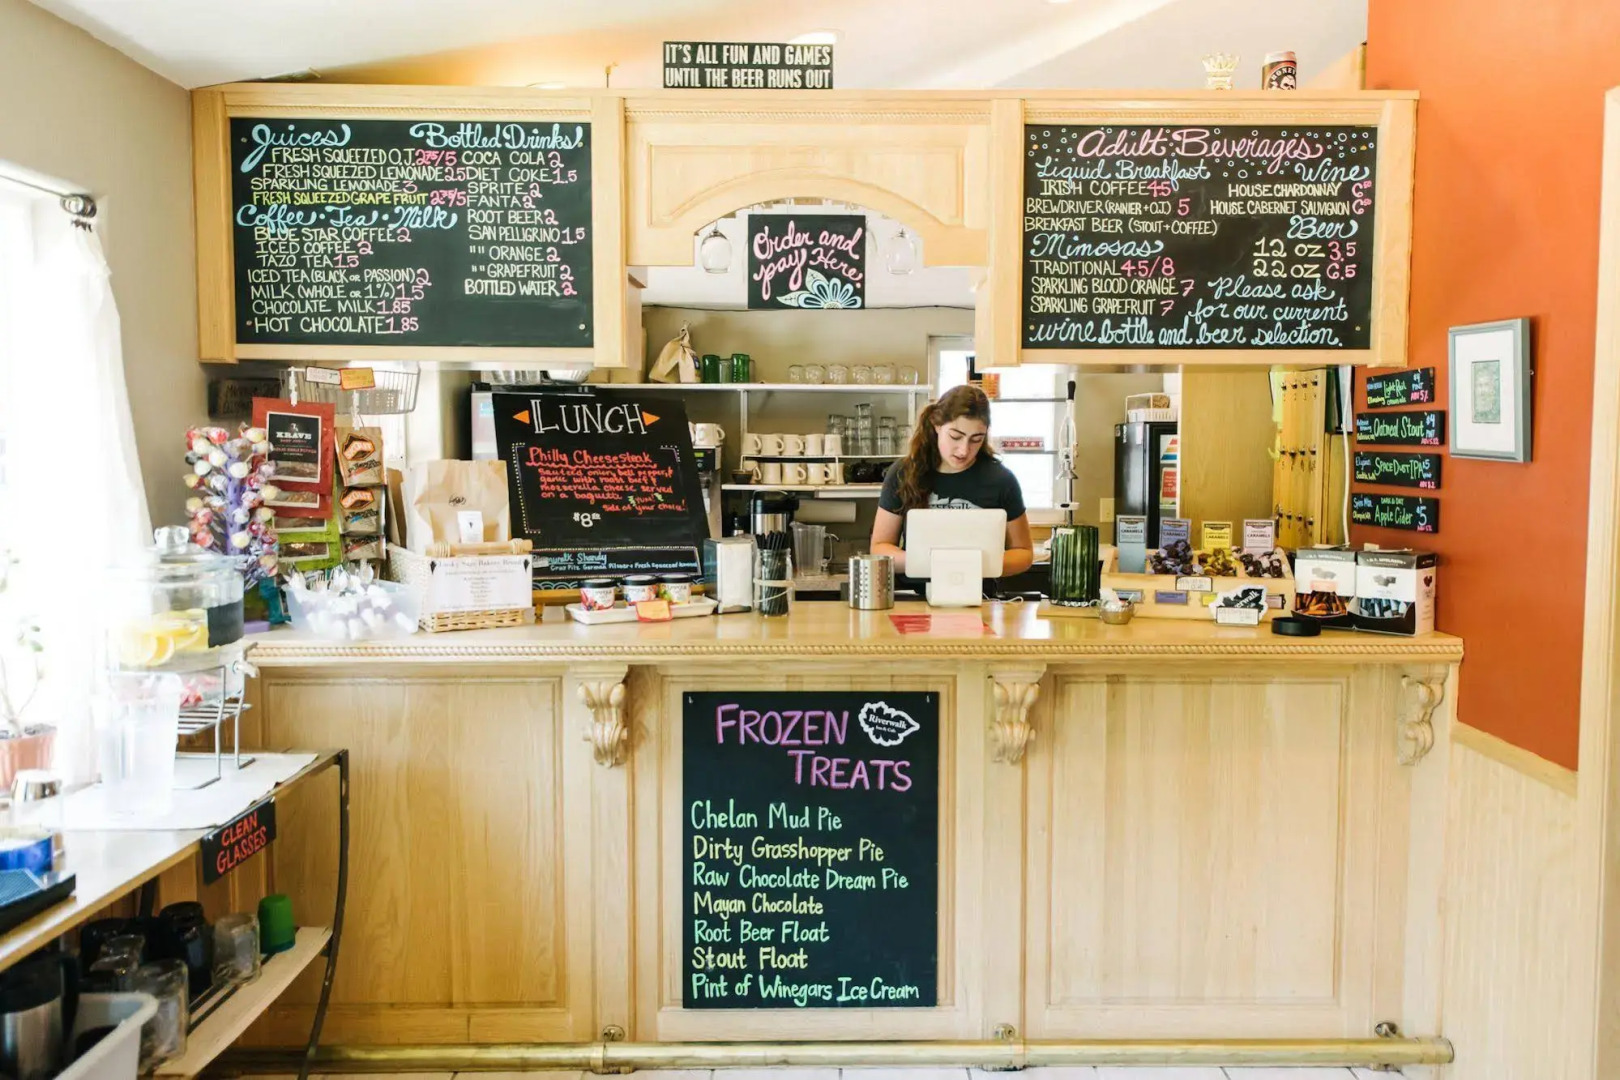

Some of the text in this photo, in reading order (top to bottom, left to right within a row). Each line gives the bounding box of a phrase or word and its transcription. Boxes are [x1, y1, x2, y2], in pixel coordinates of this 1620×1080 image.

[665, 44, 831, 65] IT'S ALL FUN AND GAMES
[665, 68, 831, 88] UNTIL THE BEER RUNS OUT
[409, 122, 502, 148] Bottled
[240, 124, 351, 173] Juices
[272, 147, 387, 165] FRESH SQUEEZED
[461, 150, 564, 168] COCA COLA 2
[1077, 128, 1323, 175] Adult Beverages
[263, 164, 444, 181] FRESH SQUEEZED LEMONADE
[466, 167, 553, 182] DIET COKE
[1035, 156, 1211, 192] Liquid Breakfast
[1294, 158, 1370, 182] Wine
[251, 177, 418, 193] SPARKLING LEMONADE 3
[467, 181, 543, 198] SPRITE 2
[1040, 179, 1149, 196] IRISH COFFEE
[1228, 182, 1342, 197] HOUSE CHARDONNAY
[253, 192, 428, 205] FRESH SQUEEZED GRAPE FRUIT
[466, 195, 536, 209] FANTA 2
[1026, 198, 1190, 216] BREWDRIVER 5
[1210, 200, 1350, 215] HOUSE CABERNET SAUVIGNON
[236, 204, 458, 234] Coffee Milk
[467, 208, 559, 225] ROOT BEER 2
[1024, 216, 1123, 233] BREAKFAST BEER
[1287, 215, 1359, 239] Beer
[254, 227, 412, 242] BLUE STAR COFFEE 2
[468, 225, 560, 242] SAN PELLIGRINO
[753, 220, 863, 260] Order and
[255, 241, 374, 255] ICED COFFEE 2
[489, 245, 561, 262] ORANGE 2
[1030, 233, 1164, 259] Mimosas
[1253, 236, 1357, 261] 12 3.5
[257, 255, 333, 267] TAZO TEA
[487, 263, 574, 280] GRAPEFRUIT 2
[1030, 260, 1121, 276] TRADITIONAL
[1253, 259, 1357, 280] 22 6.5
[248, 268, 432, 286] ICED PASSION) 2
[753, 248, 807, 301] pay
[250, 284, 346, 299] MILK (WHOLE
[464, 279, 577, 296] BOTTLED WATER 2
[1031, 276, 1195, 297] SPARKLING BLOOD ORANGE 7
[1208, 275, 1335, 301] Please ask
[252, 300, 411, 314] CHOCOLATE MILK 1.85
[1030, 295, 1175, 316] SPARKLING GRAPEFRUIT 7
[1188, 297, 1348, 324] for our current
[255, 316, 385, 334] HOT CHOCOLATE
[1029, 315, 1247, 345] wine bottle and beer
[530, 399, 647, 434] LUNCH
[1400, 415, 1425, 438] Stout
[276, 431, 312, 439] KRAVE
[529, 446, 568, 467] Philly
[1374, 504, 1393, 526] Apple
[1395, 506, 1413, 525] Cider
[577, 552, 607, 566] Shandy
[716, 703, 849, 745] FROZEN
[869, 714, 907, 730] Riverwalk
[787, 750, 912, 791] TREATS
[691, 798, 842, 830] Chelan Mud Pie
[221, 811, 257, 845] CLEAN
[216, 826, 266, 873] GLASSES
[693, 835, 884, 866] Dirty Grasshopper Pie
[693, 861, 908, 890] Raw Chocolate Dream Pie
[693, 891, 824, 919] Mayan Chocolate
[694, 919, 830, 943] Root Beer Float
[692, 946, 808, 970] Stout Float
[692, 973, 919, 1007] Pint of Winegars Ice Cream
